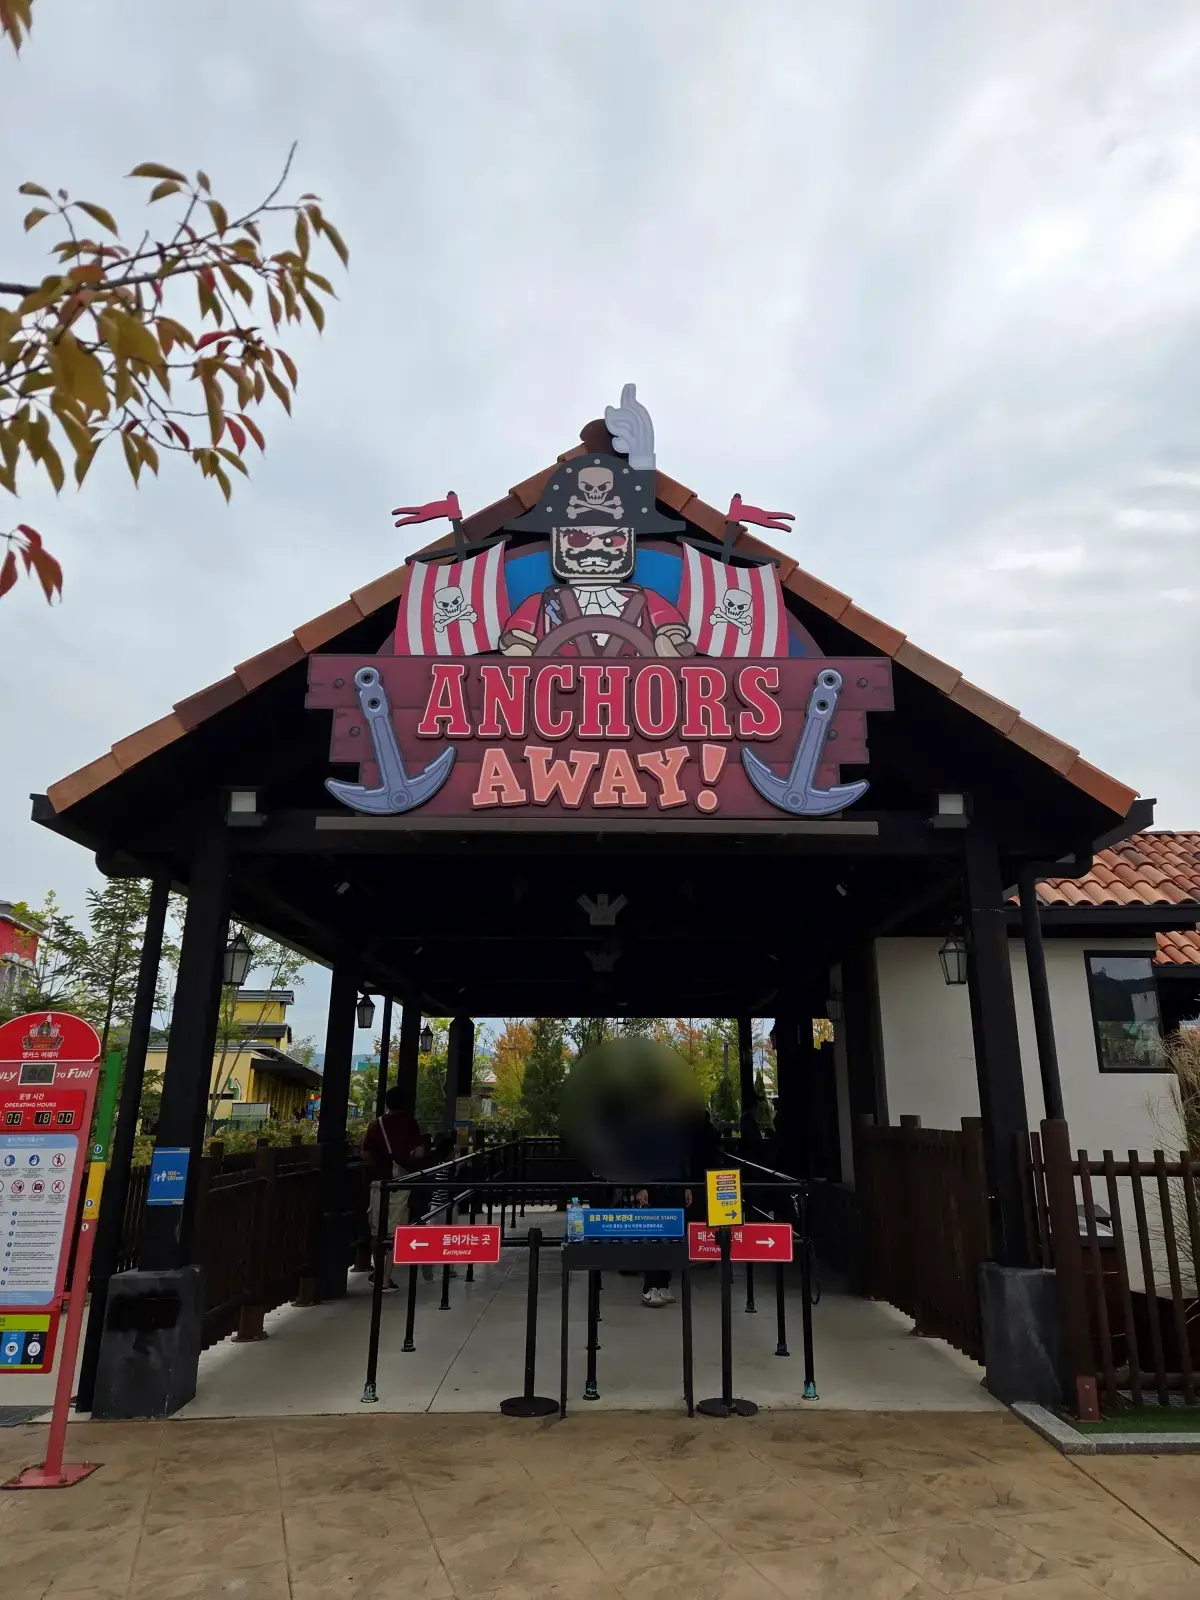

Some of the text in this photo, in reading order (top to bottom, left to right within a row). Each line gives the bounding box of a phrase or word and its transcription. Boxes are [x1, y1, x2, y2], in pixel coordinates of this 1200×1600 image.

[416, 664, 783, 741] ANCHORS
[472, 744, 728, 813] AWAY!
[67, 1068, 94, 1079] FUN!
[19, 1093, 31, 1101] 운영
[589, 1214, 601, 1222] 음료
[602, 1214, 614, 1222] 자율
[615, 1214, 633, 1222] 보관대
[442, 1234, 491, 1246] 들어가는 곳
[442, 1248, 472, 1256] ENTRANCE
